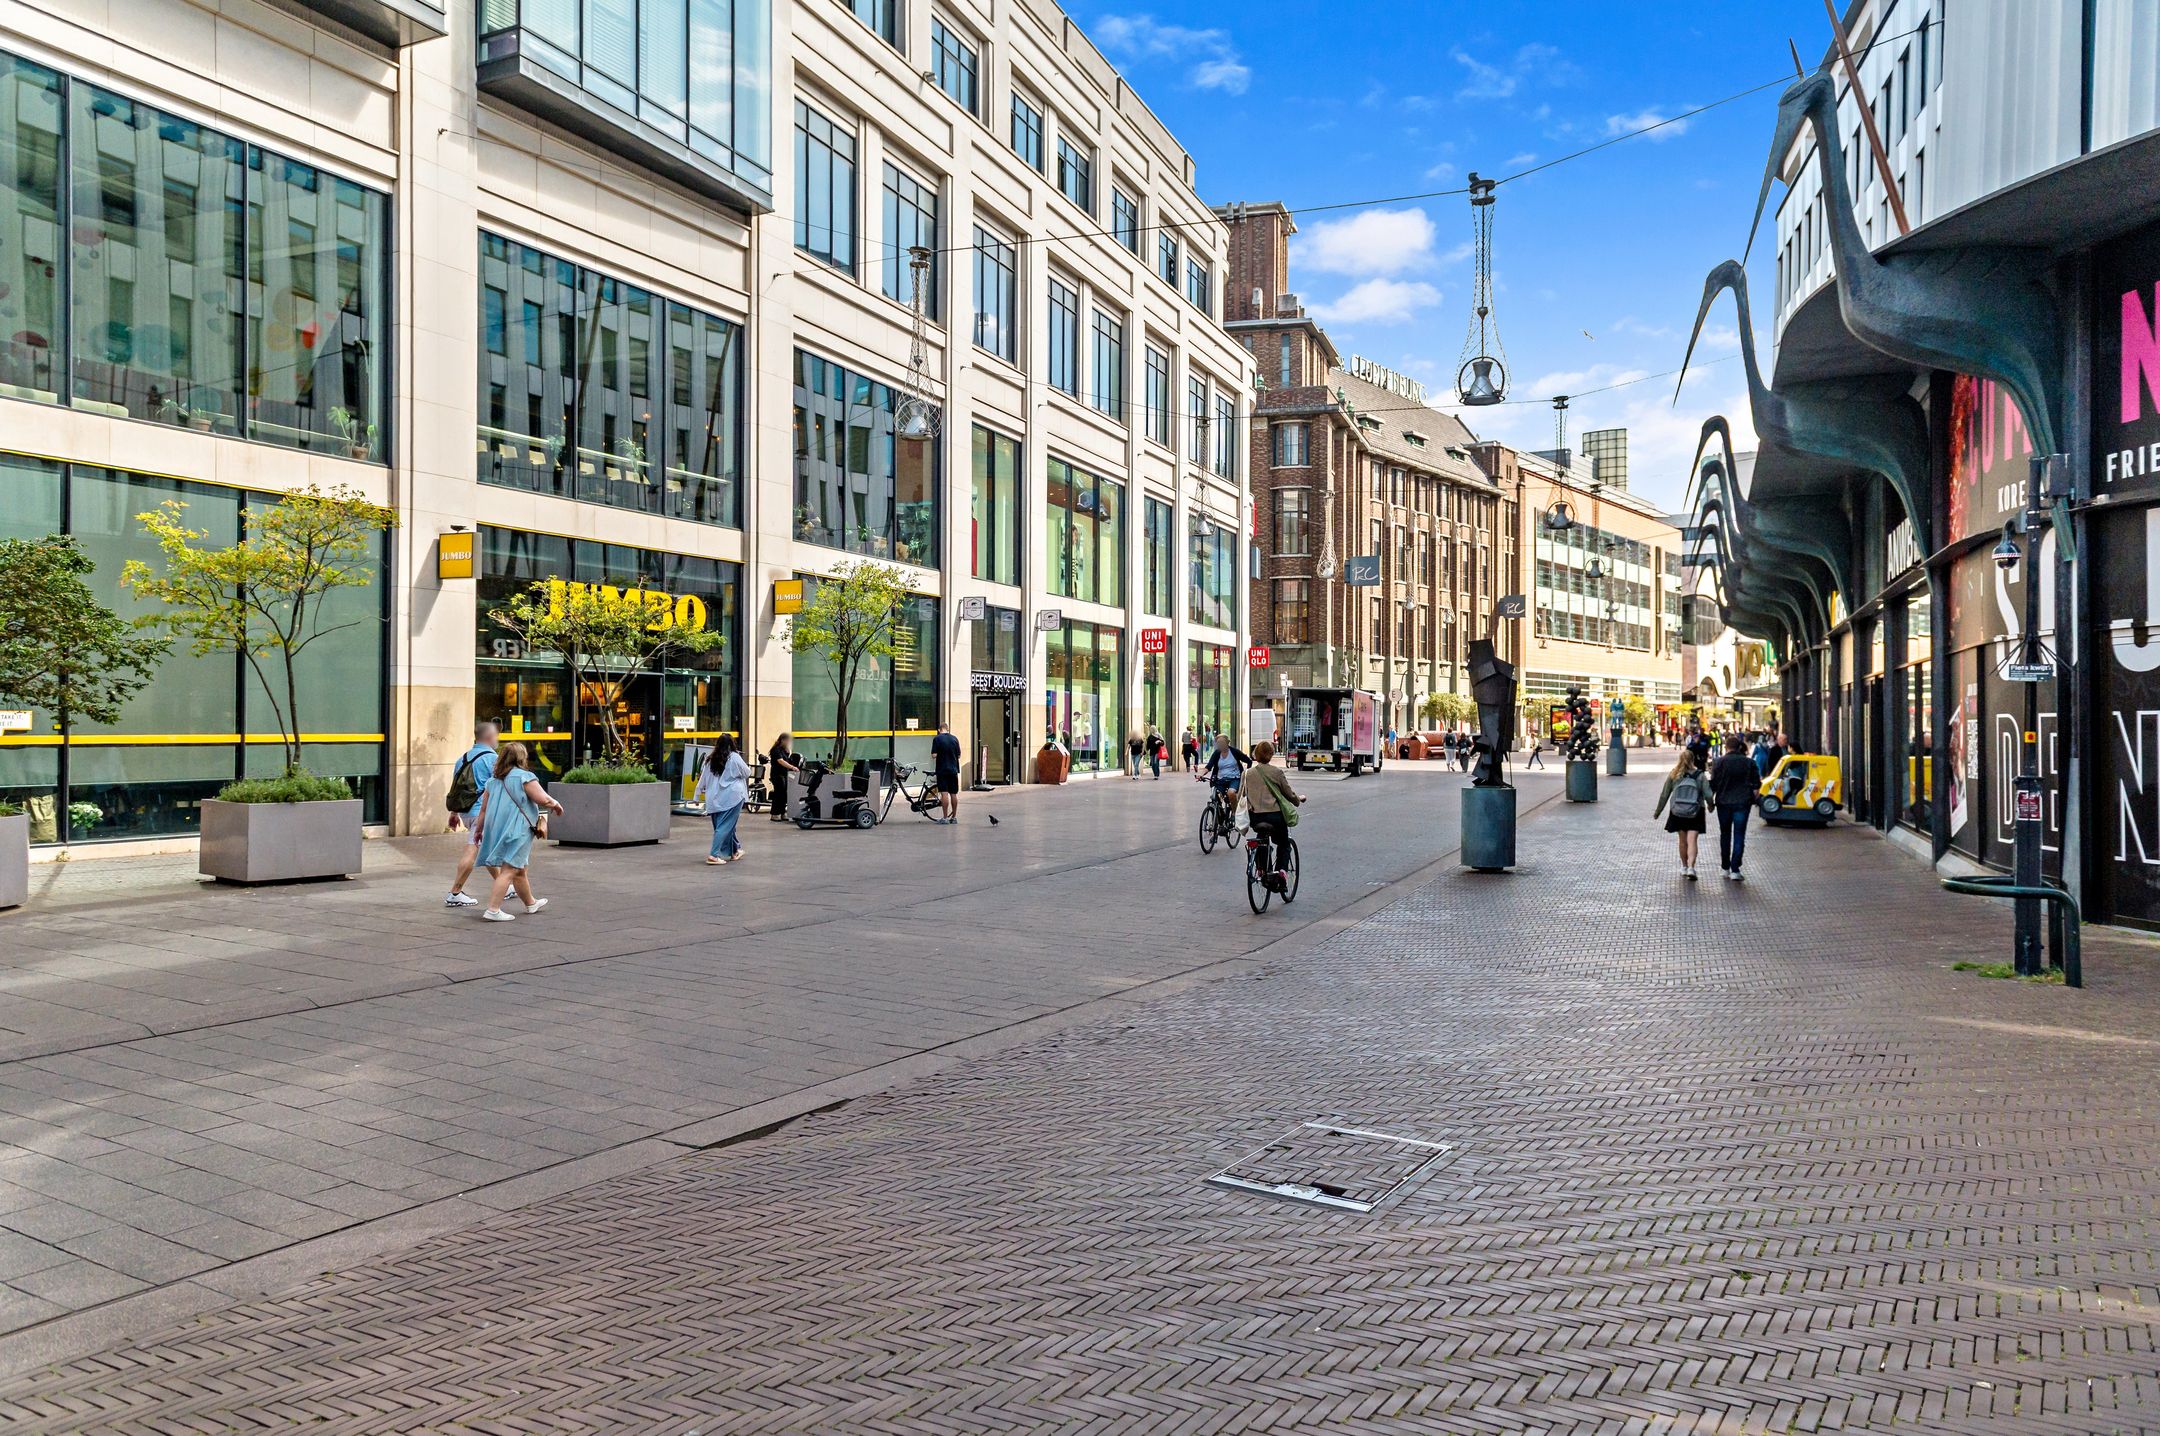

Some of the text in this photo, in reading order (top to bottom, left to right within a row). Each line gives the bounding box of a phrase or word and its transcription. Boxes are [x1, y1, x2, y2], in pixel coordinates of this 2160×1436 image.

[441, 551, 472, 561] JUMBO
[776, 593, 801, 601] JUMBO
[547, 579, 707, 633] JUMBO
[1144, 631, 1161, 640] UNI
[1144, 641, 1163, 651] QLO
[1251, 649, 1266, 657] UNI
[1251, 658, 1267, 666] QLO
[970, 674, 1027, 690] BEEST BOULDERS
